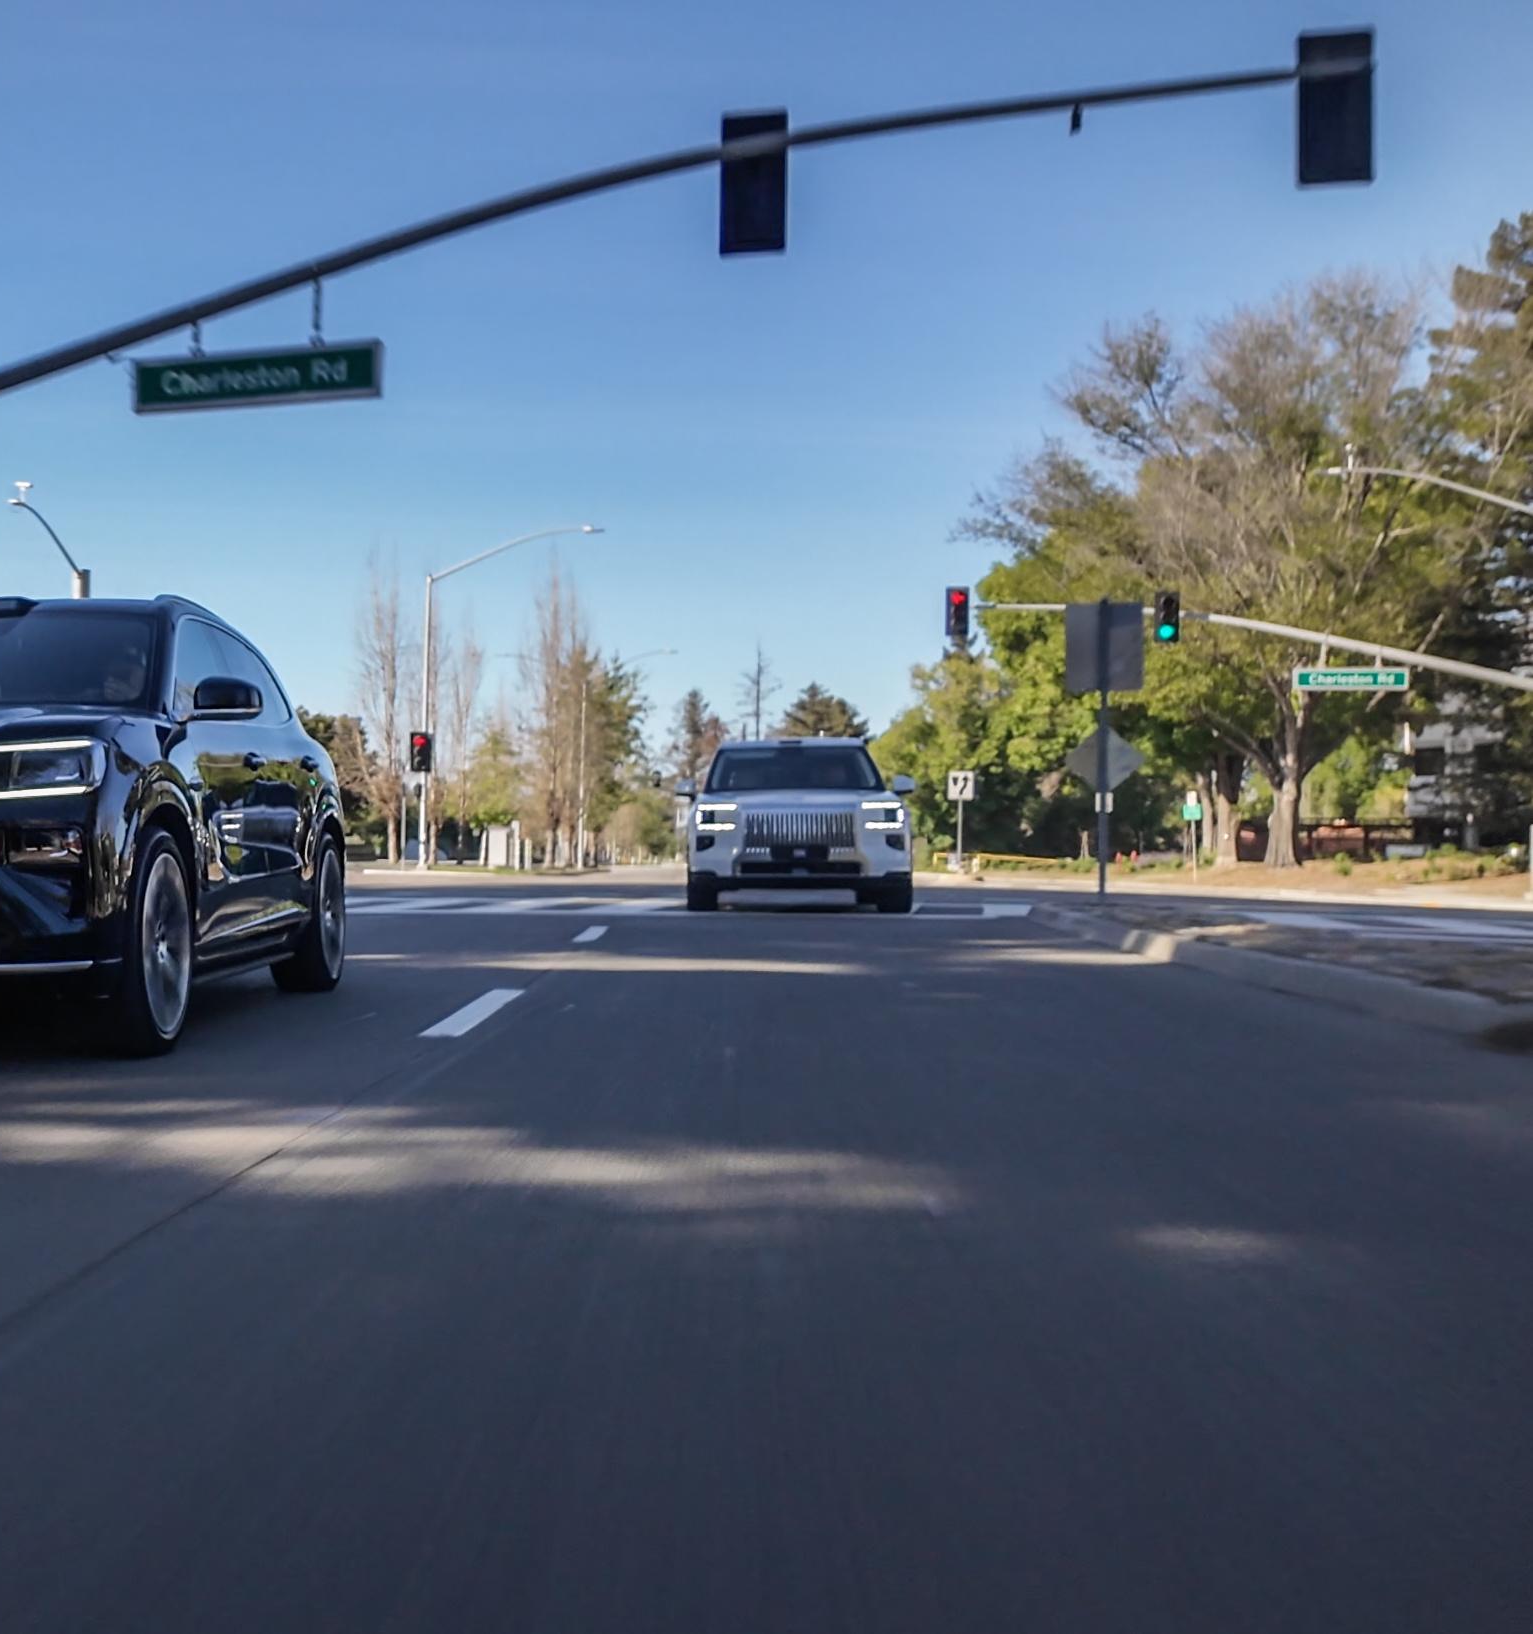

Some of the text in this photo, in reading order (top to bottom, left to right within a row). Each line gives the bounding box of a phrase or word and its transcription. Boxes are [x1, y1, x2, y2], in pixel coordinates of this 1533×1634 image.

[160, 356, 348, 396] Charleston Rd
[1308, 672, 1395, 686] Charleston Rd
